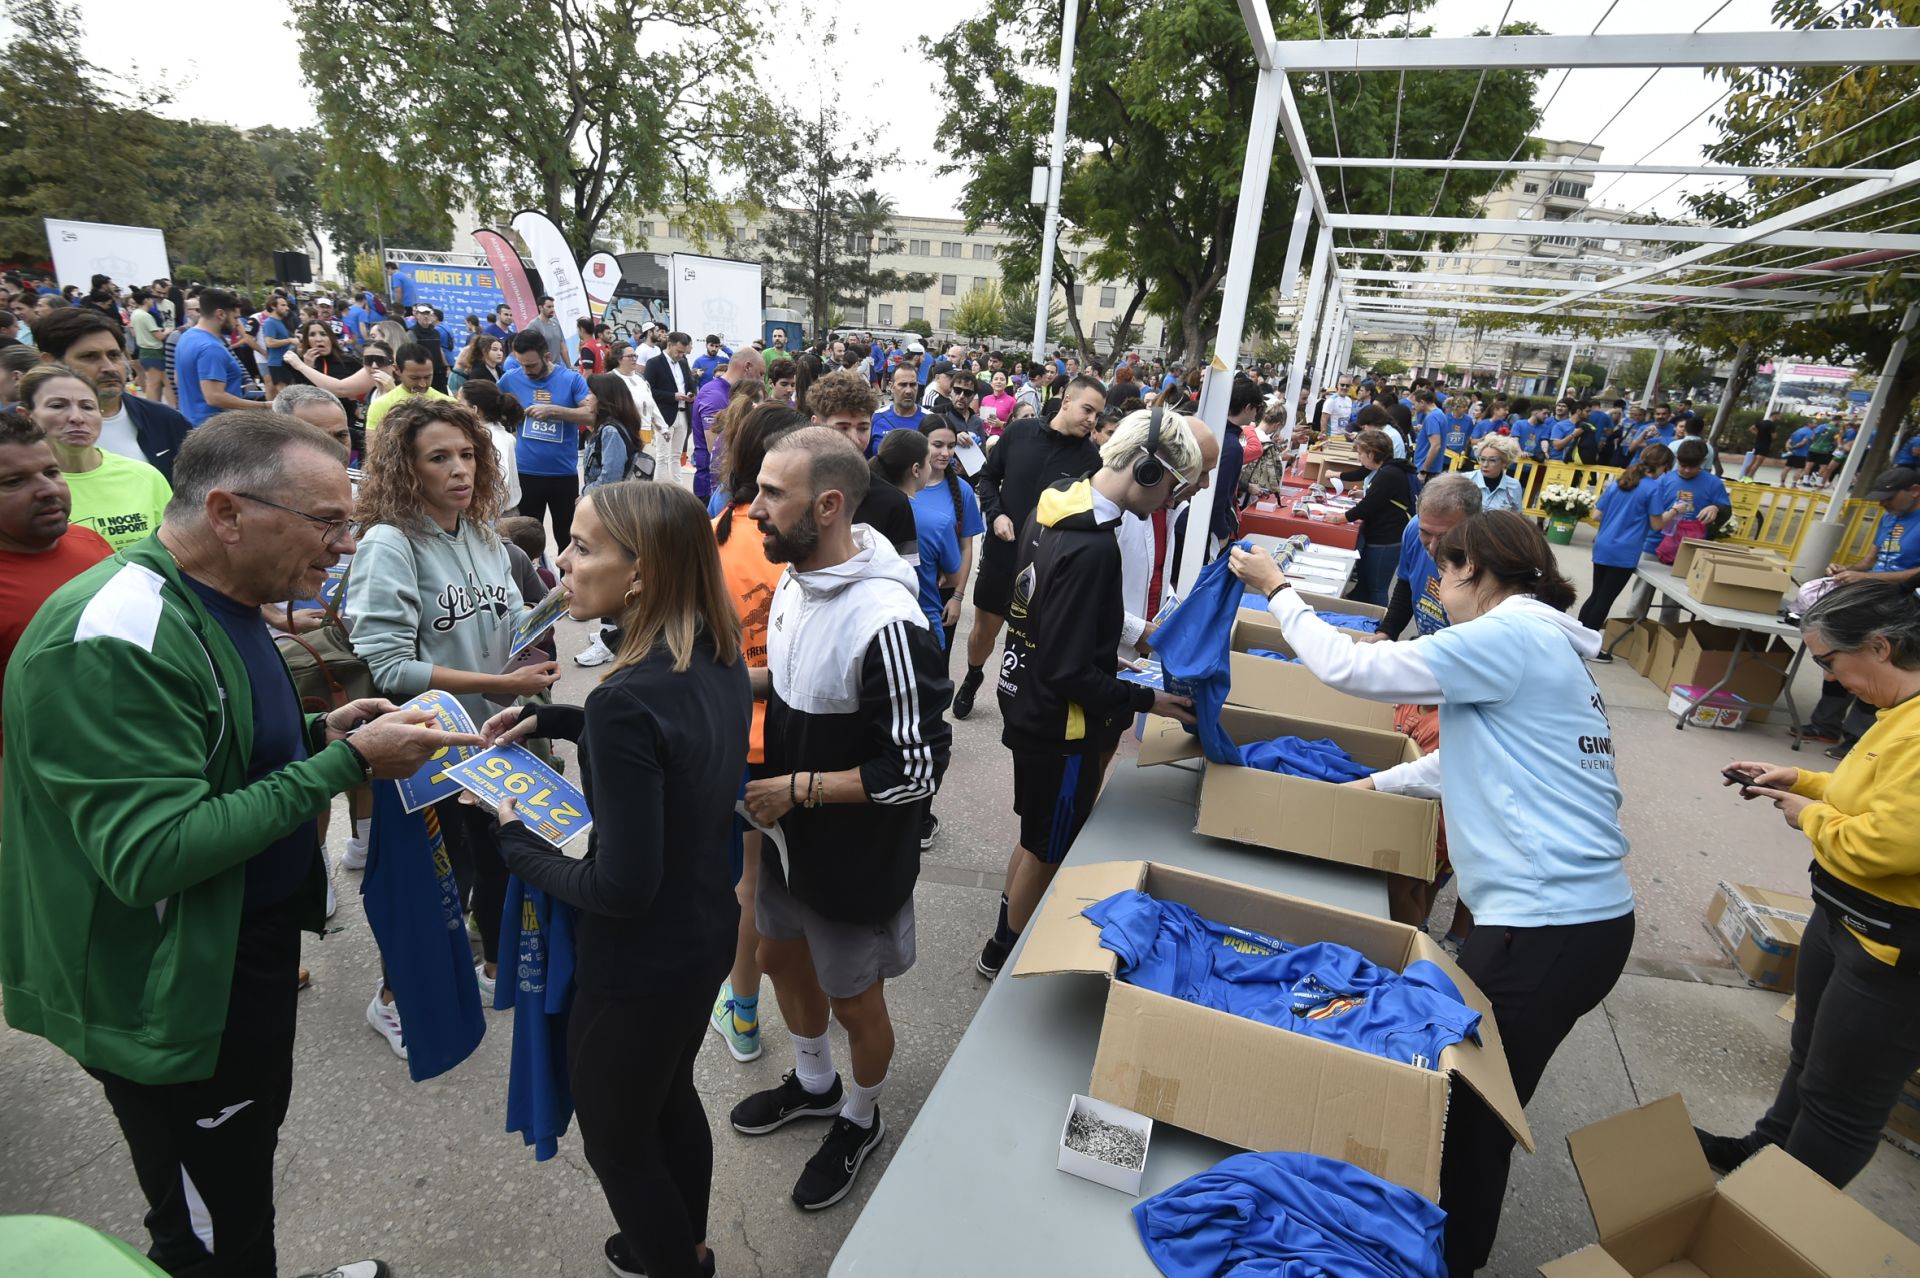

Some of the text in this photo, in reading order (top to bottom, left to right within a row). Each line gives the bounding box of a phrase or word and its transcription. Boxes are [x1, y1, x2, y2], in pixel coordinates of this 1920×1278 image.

[415, 268, 473, 287] MUÉVETE X
[532, 420, 557, 433] 634
[107, 513, 142, 526] NOCHE
[107, 521, 148, 535] DEPORTE
[462, 767, 500, 795] VALENCIA
[477, 757, 583, 825] 2195
